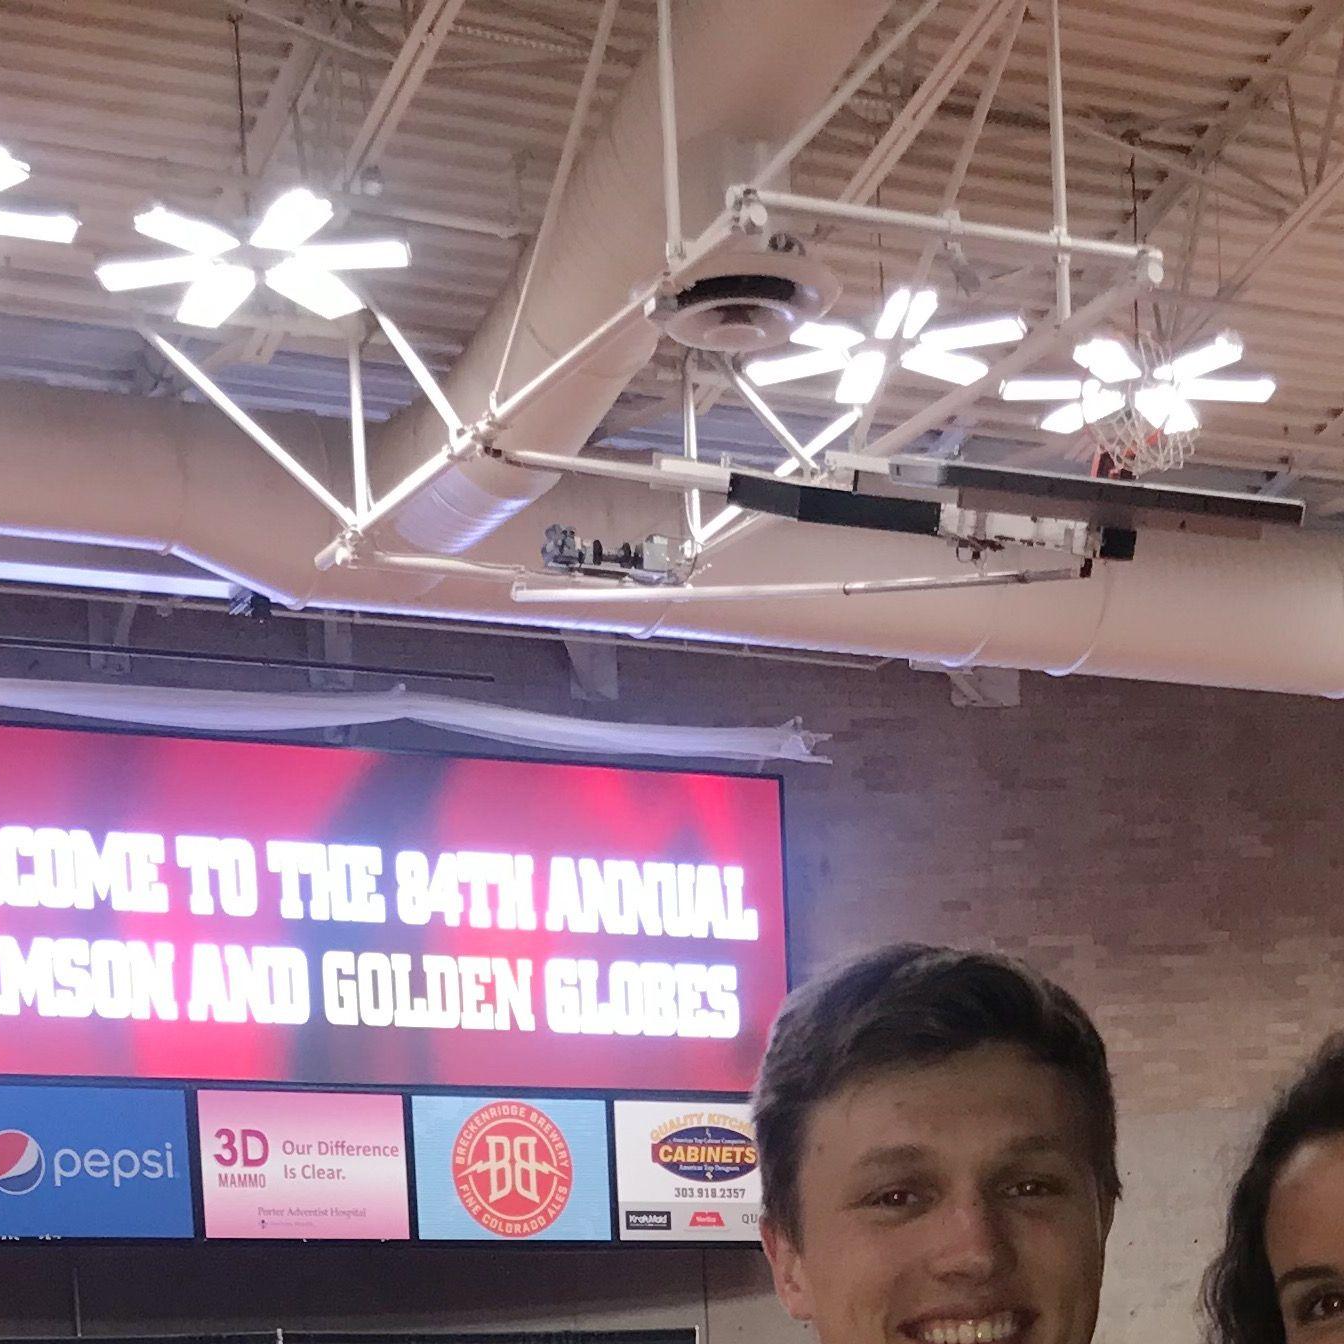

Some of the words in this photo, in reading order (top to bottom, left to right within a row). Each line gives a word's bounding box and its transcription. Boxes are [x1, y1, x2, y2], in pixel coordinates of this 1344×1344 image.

[175, 834, 259, 917] TO
[266, 839, 386, 923] THE
[395, 849, 537, 931] 84TH
[544, 855, 759, 941] ANNUAL
[188, 942, 311, 1025] AND
[322, 950, 536, 1032] GOLDEN
[543, 957, 741, 1039] GLOBES
[455, 1104, 526, 1165] BRECKENRIDGE
[529, 1111, 570, 1168] BREWERY
[651, 1112, 704, 1141] QUALITY
[213, 1128, 270, 1168] 3D
[282, 1140, 314, 1156] Our
[318, 1140, 400, 1158] Difference
[658, 1144, 757, 1164] CABINETS
[54, 1141, 175, 1188] pepsi
[284, 1164, 297, 1180] Is
[301, 1164, 347, 1181] Clear.
[218, 1173, 267, 1189] MAMMO
[674, 1187, 746, 1199] 303.918.2357
[459, 1184, 482, 1216] FINE
[481, 1213, 547, 1234] COLORADO
[548, 1185, 569, 1219] ALES
[742, 1213, 758, 1224] QU
